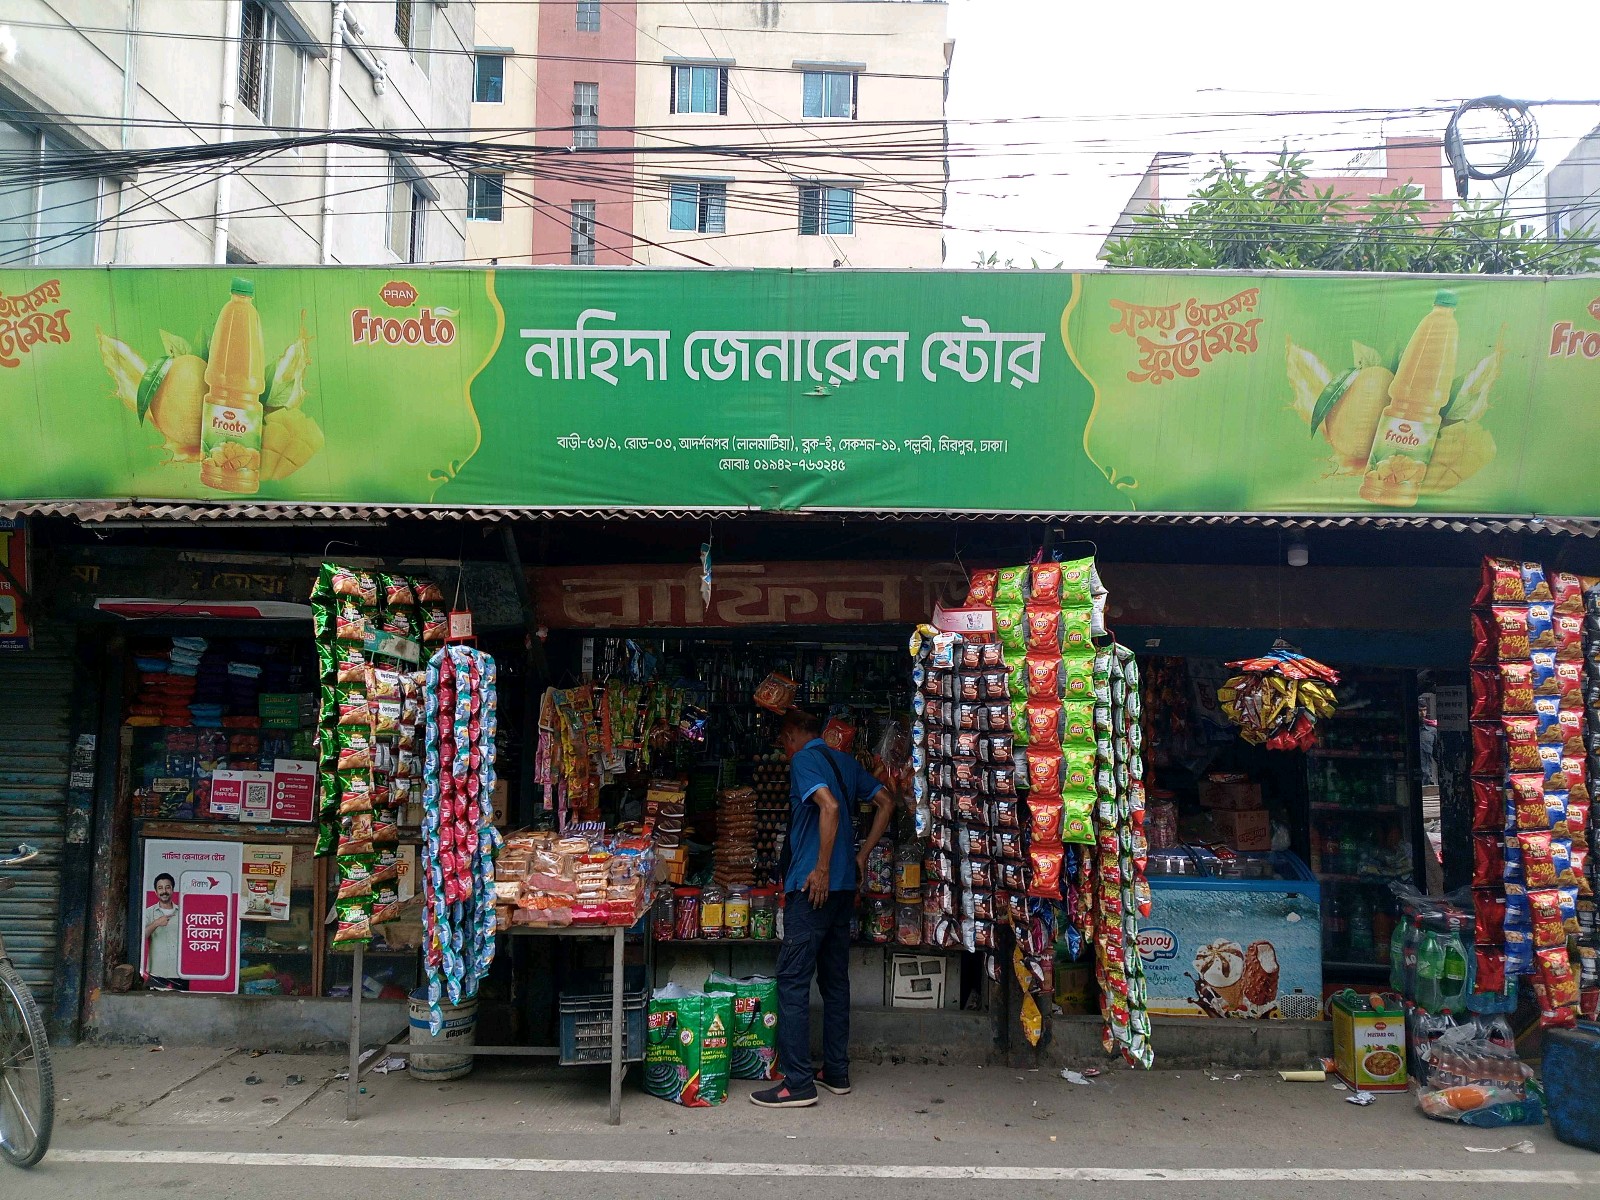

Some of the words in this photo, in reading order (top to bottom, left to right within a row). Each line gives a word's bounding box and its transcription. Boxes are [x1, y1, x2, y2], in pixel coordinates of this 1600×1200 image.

[384, 290, 414, 299] PRAN
[1108, 298, 1181, 339] সময়
[1185, 287, 1260, 327] অসময়
[352, 308, 456, 346] Frooto
[1549, 321, 1600, 358] Fro
[520, 309, 671, 386] নাহিদা
[684, 330, 910, 388] জেনারেল
[922, 316, 1046, 390] ষ্টোর
[213, 417, 247, 434] Frooto
[625, 436, 676, 451] রোড-০৩,
[839, 438, 901, 453] সেকশন-১১,
[904, 434, 936, 454] পল্লবী,
[939, 435, 977, 456] মিরপুর,
[1385, 430, 1420, 446] Frooto
[754, 458, 846, 472] ০১৯৪২-৭৬৩২৪৫
[186, 912, 224, 925] পেমেন্ট
[187, 925, 224, 939] বিকাশ
[189, 940, 220, 952] করুন
[1135, 935, 1172, 950] Savoy
